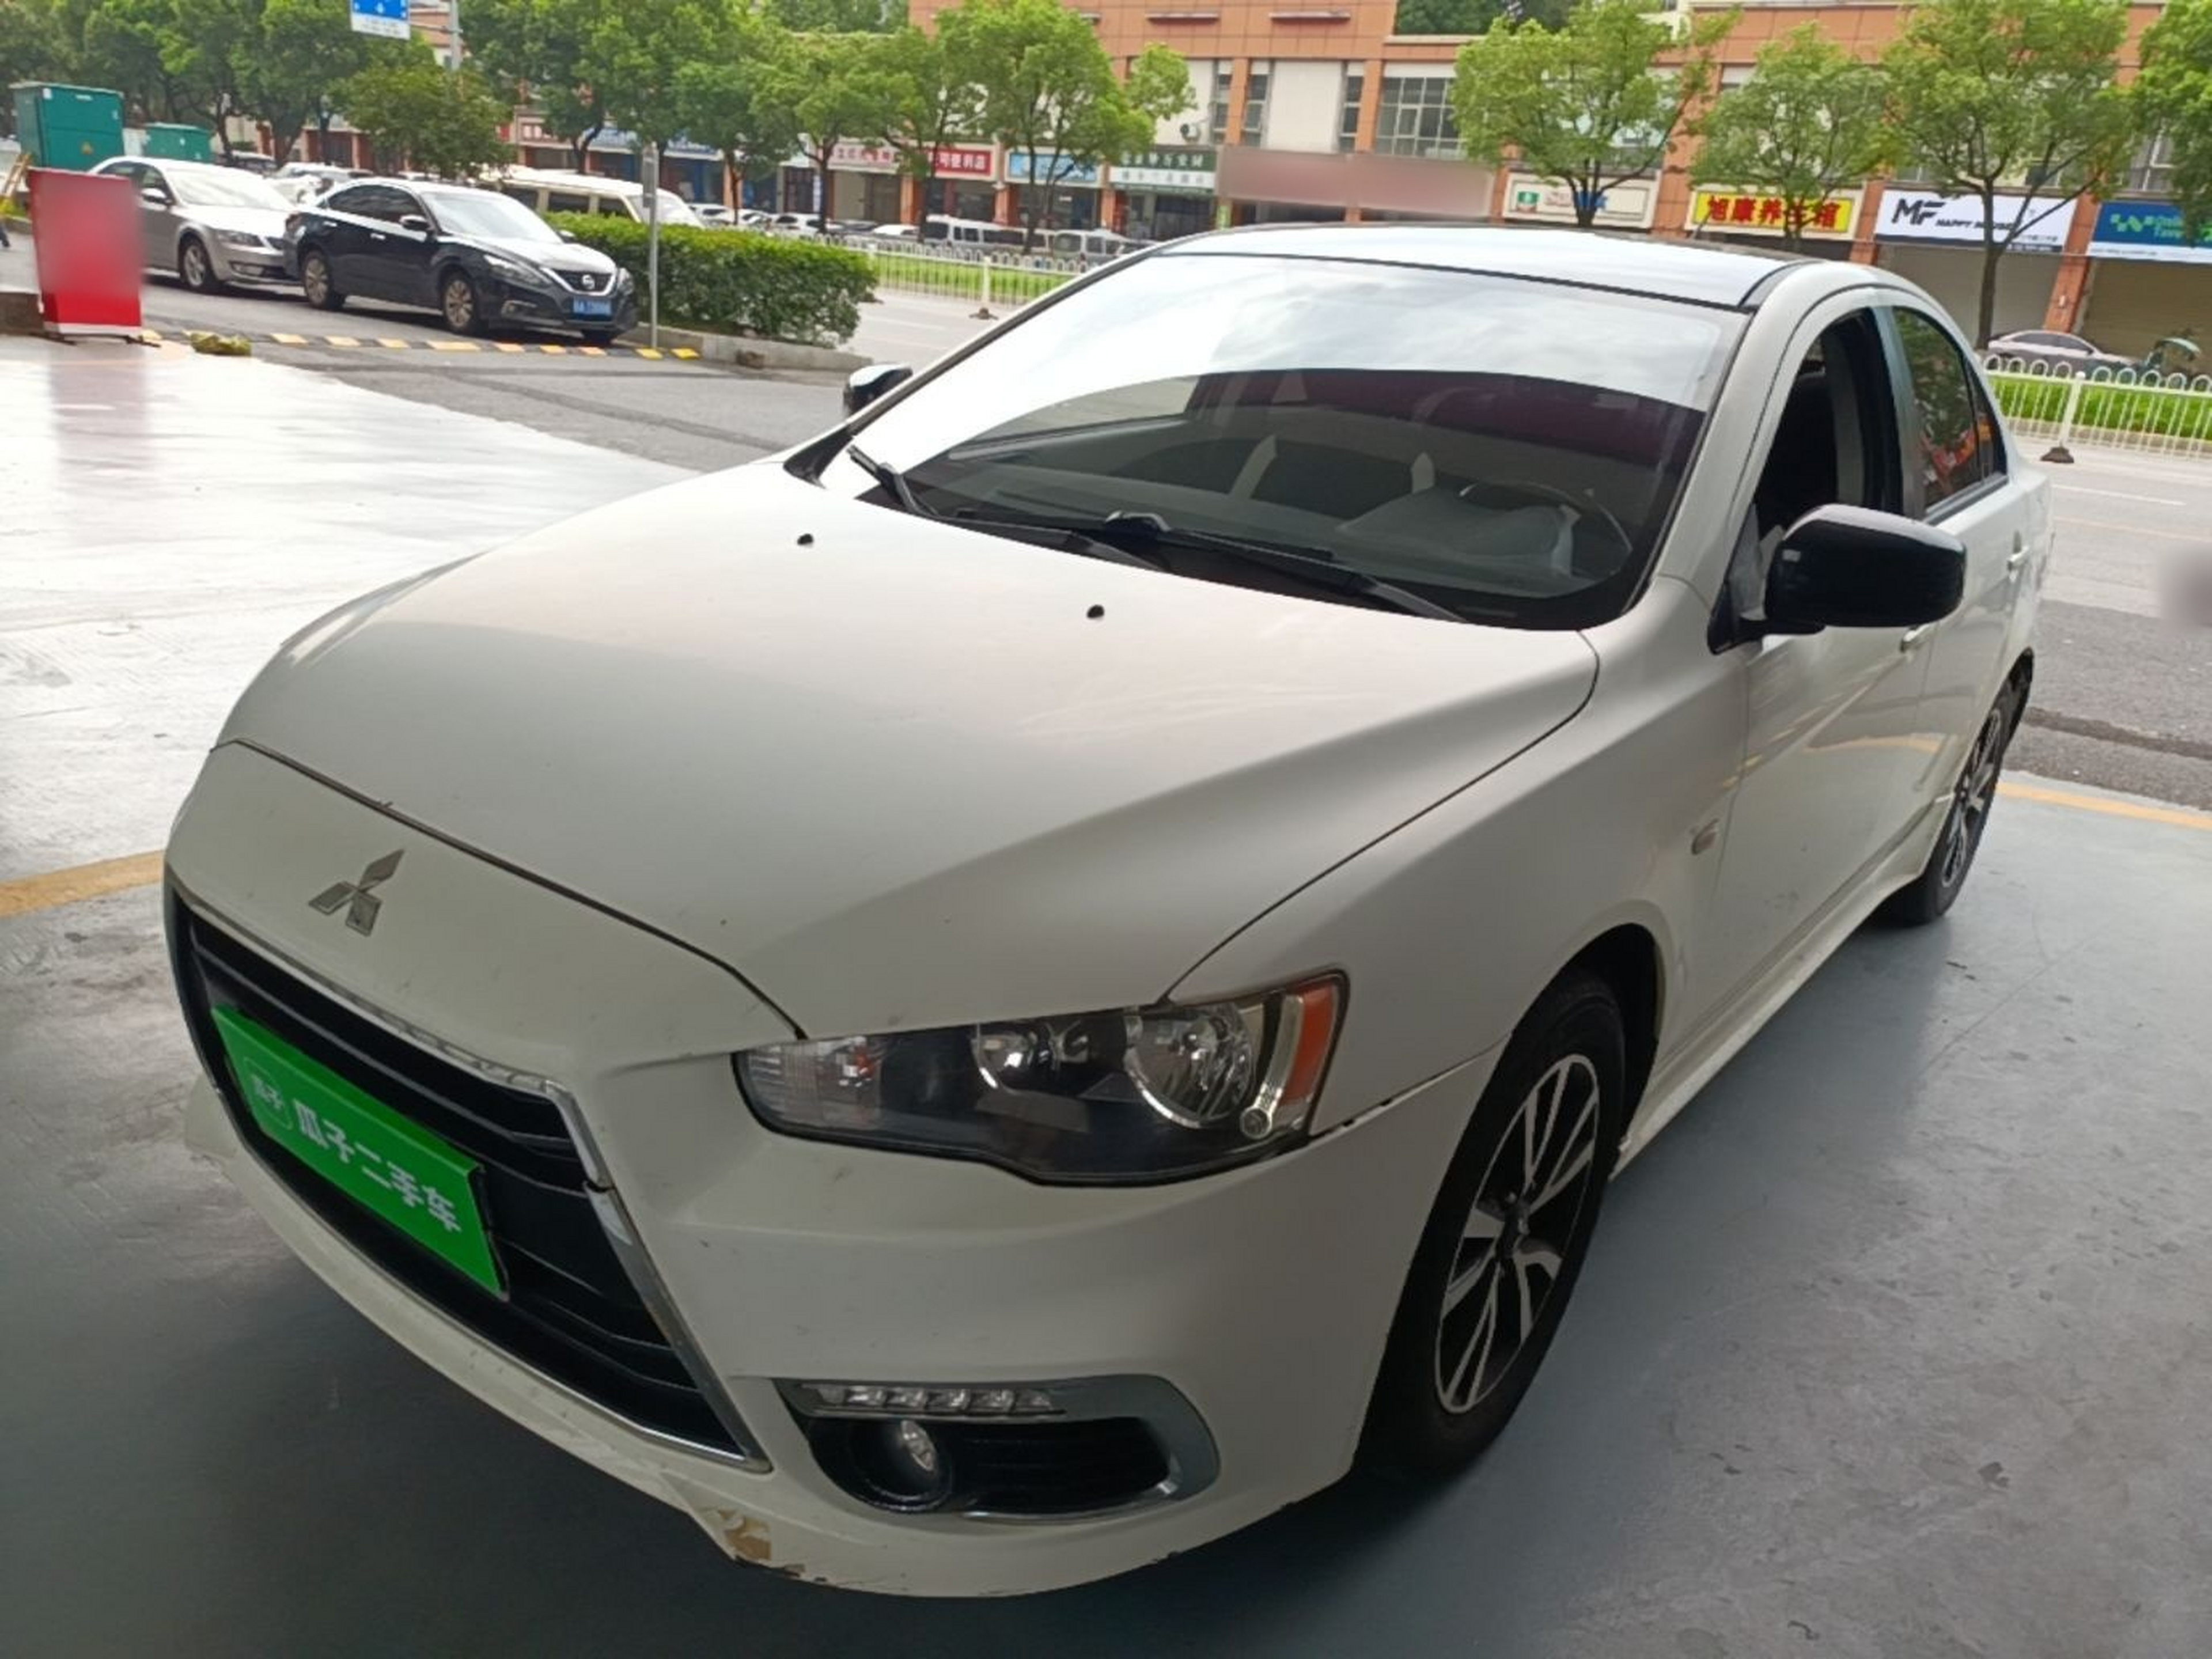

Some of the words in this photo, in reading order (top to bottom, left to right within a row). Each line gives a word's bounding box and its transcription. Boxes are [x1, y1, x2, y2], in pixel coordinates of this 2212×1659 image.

[1892, 199, 1946, 225] MF
[293, 1098, 461, 1232] 瓜子二手车
